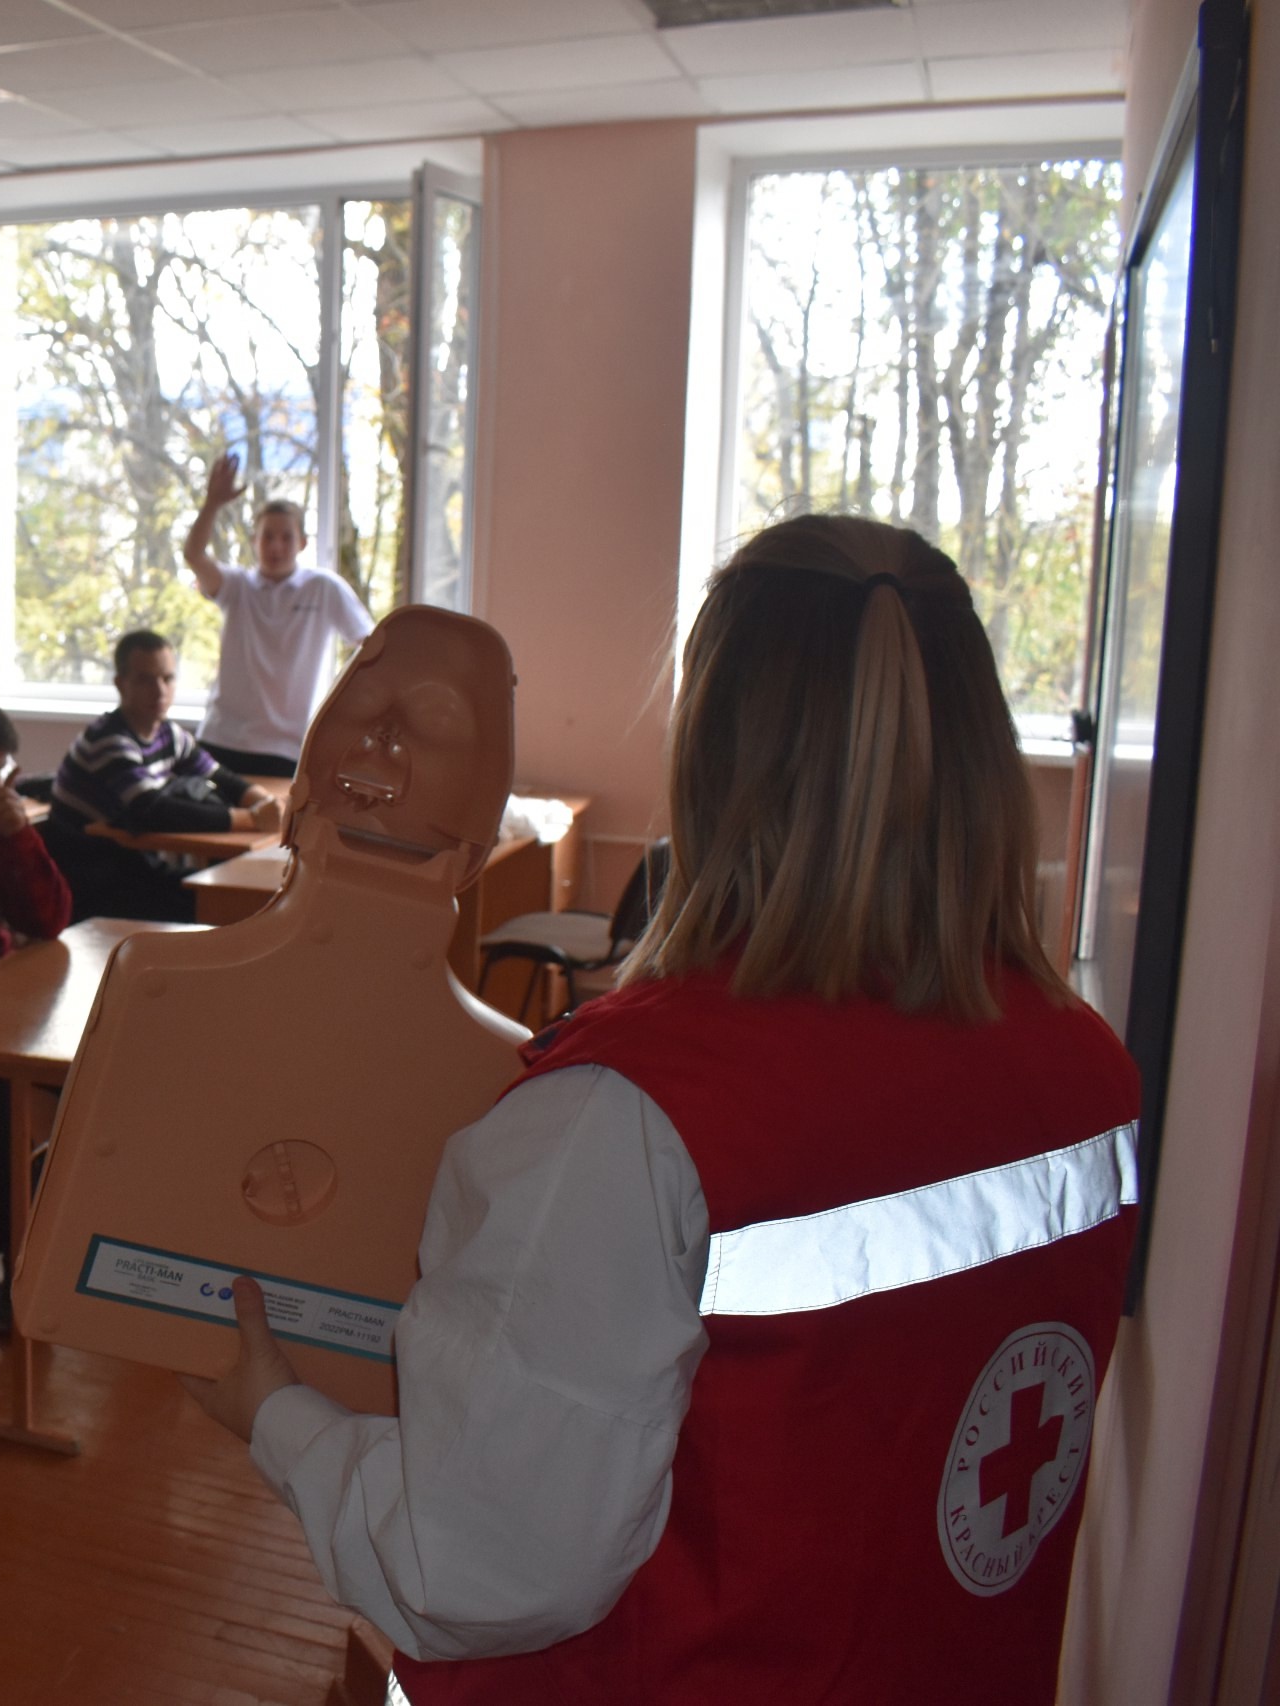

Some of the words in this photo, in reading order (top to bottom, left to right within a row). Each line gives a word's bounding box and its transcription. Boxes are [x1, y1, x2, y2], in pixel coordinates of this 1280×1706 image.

[115, 1258, 184, 1282] PRACTI-MAN
[327, 1306, 385, 1327] PRACTI-MAN
[957, 1342, 1088, 1473] РОССИЙСКИЙ
[950, 1504, 1023, 1579] КРАСНЫЙ
